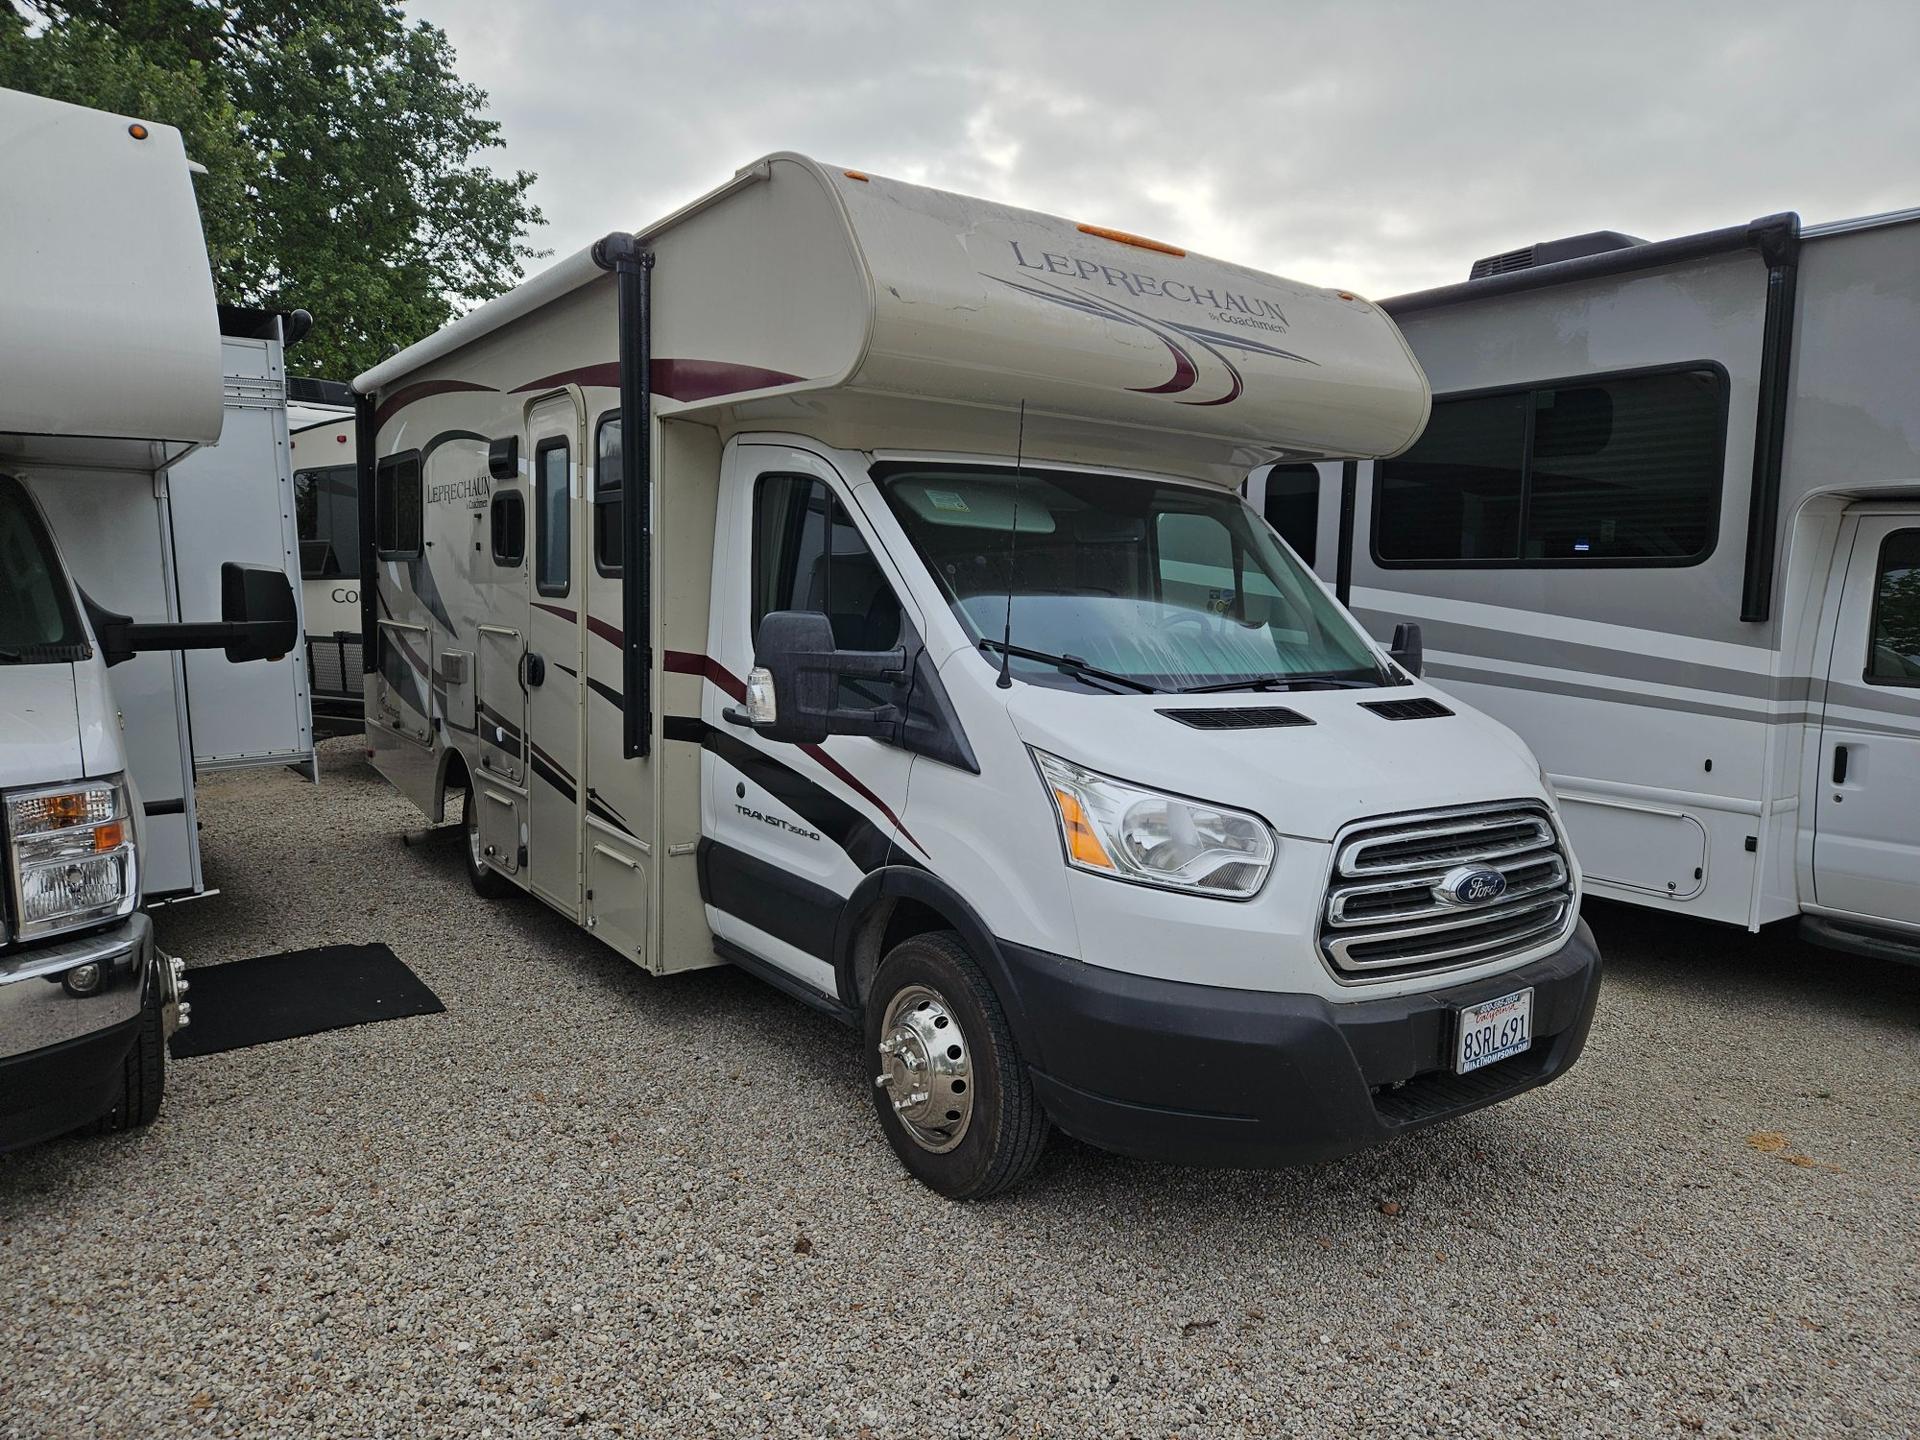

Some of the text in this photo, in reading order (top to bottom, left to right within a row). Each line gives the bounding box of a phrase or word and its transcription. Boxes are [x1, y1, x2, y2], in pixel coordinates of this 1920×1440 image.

[1008, 240, 1290, 328] LEPRECHAUN
[1219, 312, 1287, 335] Coachmen
[427, 476, 490, 504] LEPRECHAUN
[1468, 877, 1499, 899] Ford
[1463, 1014, 1526, 1061] 8SRL691
